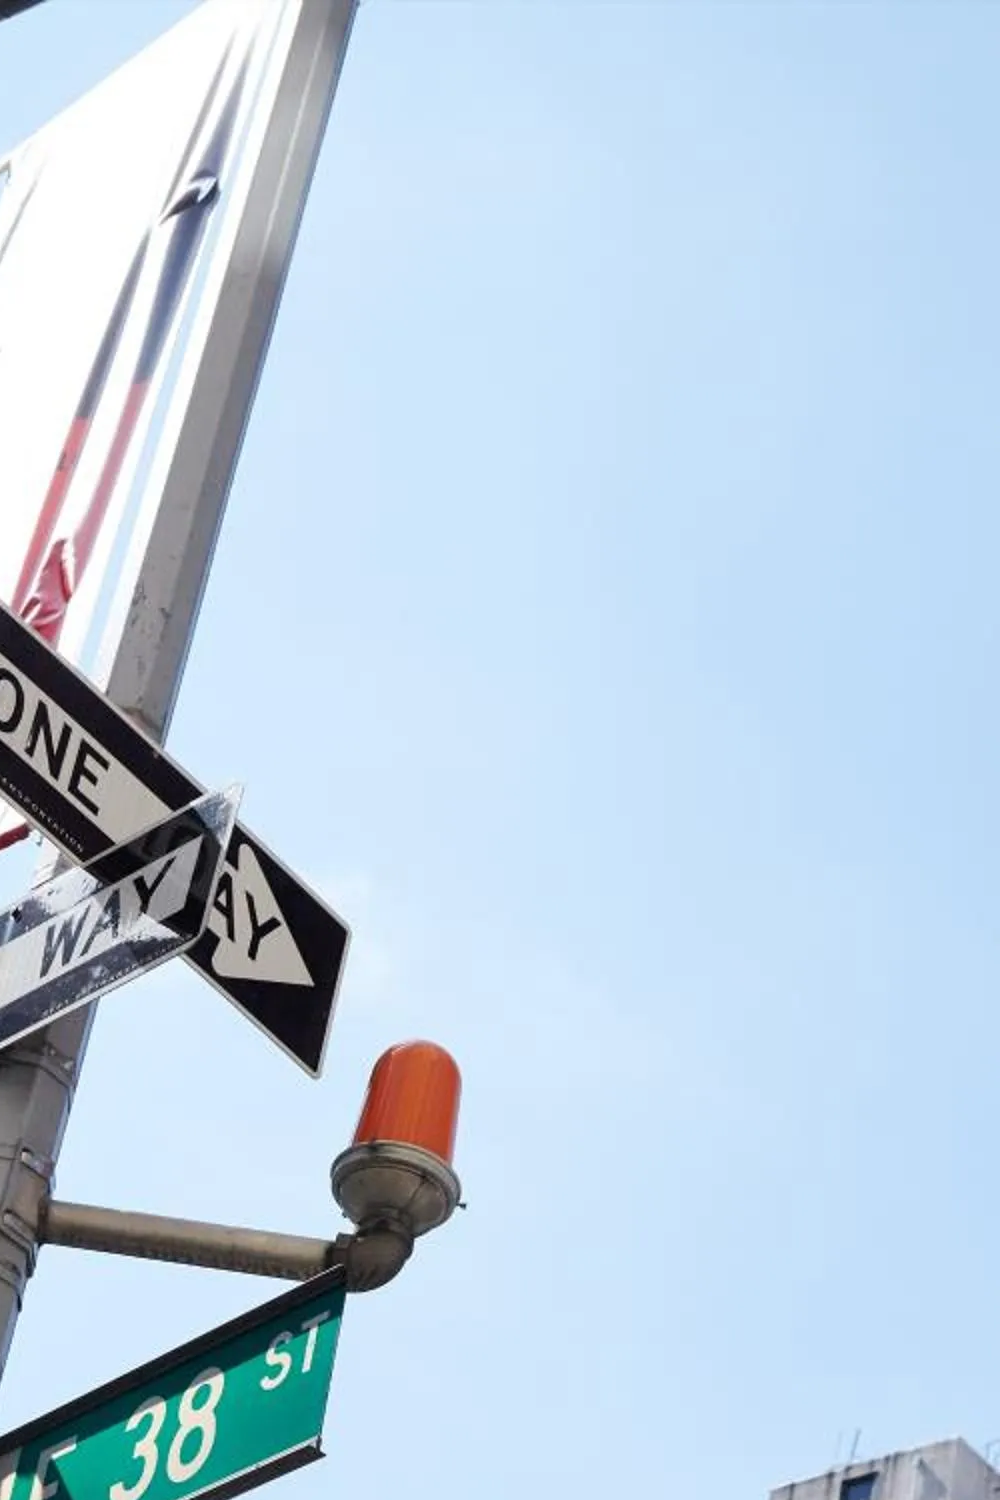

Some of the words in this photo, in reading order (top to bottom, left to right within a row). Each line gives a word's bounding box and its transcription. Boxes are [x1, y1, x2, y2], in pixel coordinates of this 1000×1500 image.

[39, 855, 177, 979] WAY
[214, 871, 282, 961] AY
[260, 1310, 330, 1391] ST
